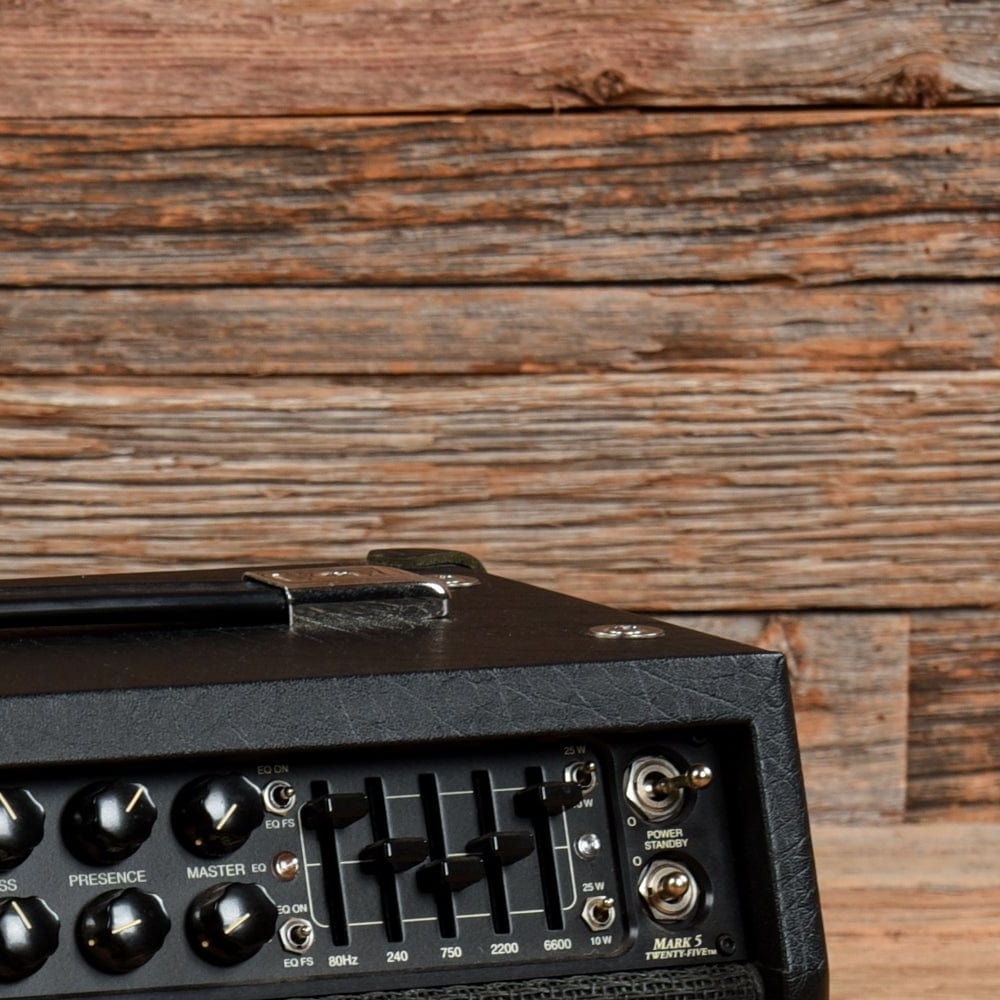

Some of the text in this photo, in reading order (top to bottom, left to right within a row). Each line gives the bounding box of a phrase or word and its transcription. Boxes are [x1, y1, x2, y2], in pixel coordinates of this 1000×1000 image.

[257, 764, 289, 775] EQ ON
[265, 818, 296, 829] EQ FS
[646, 828, 684, 839] POWER
[644, 838, 689, 851] STANDBY
[186, 863, 246, 880] MASTER
[251, 863, 267, 873] EQ
[68, 869, 147, 887] PRESENCE
[582, 883, 593, 892] 25
[277, 903, 308, 914] EQ ON
[590, 936, 600, 946] 10
[653, 934, 703, 950] MARK 5
[328, 938, 572, 967] 80Hz 240 750 2200 6600
[283, 956, 314, 968] EQ FS
